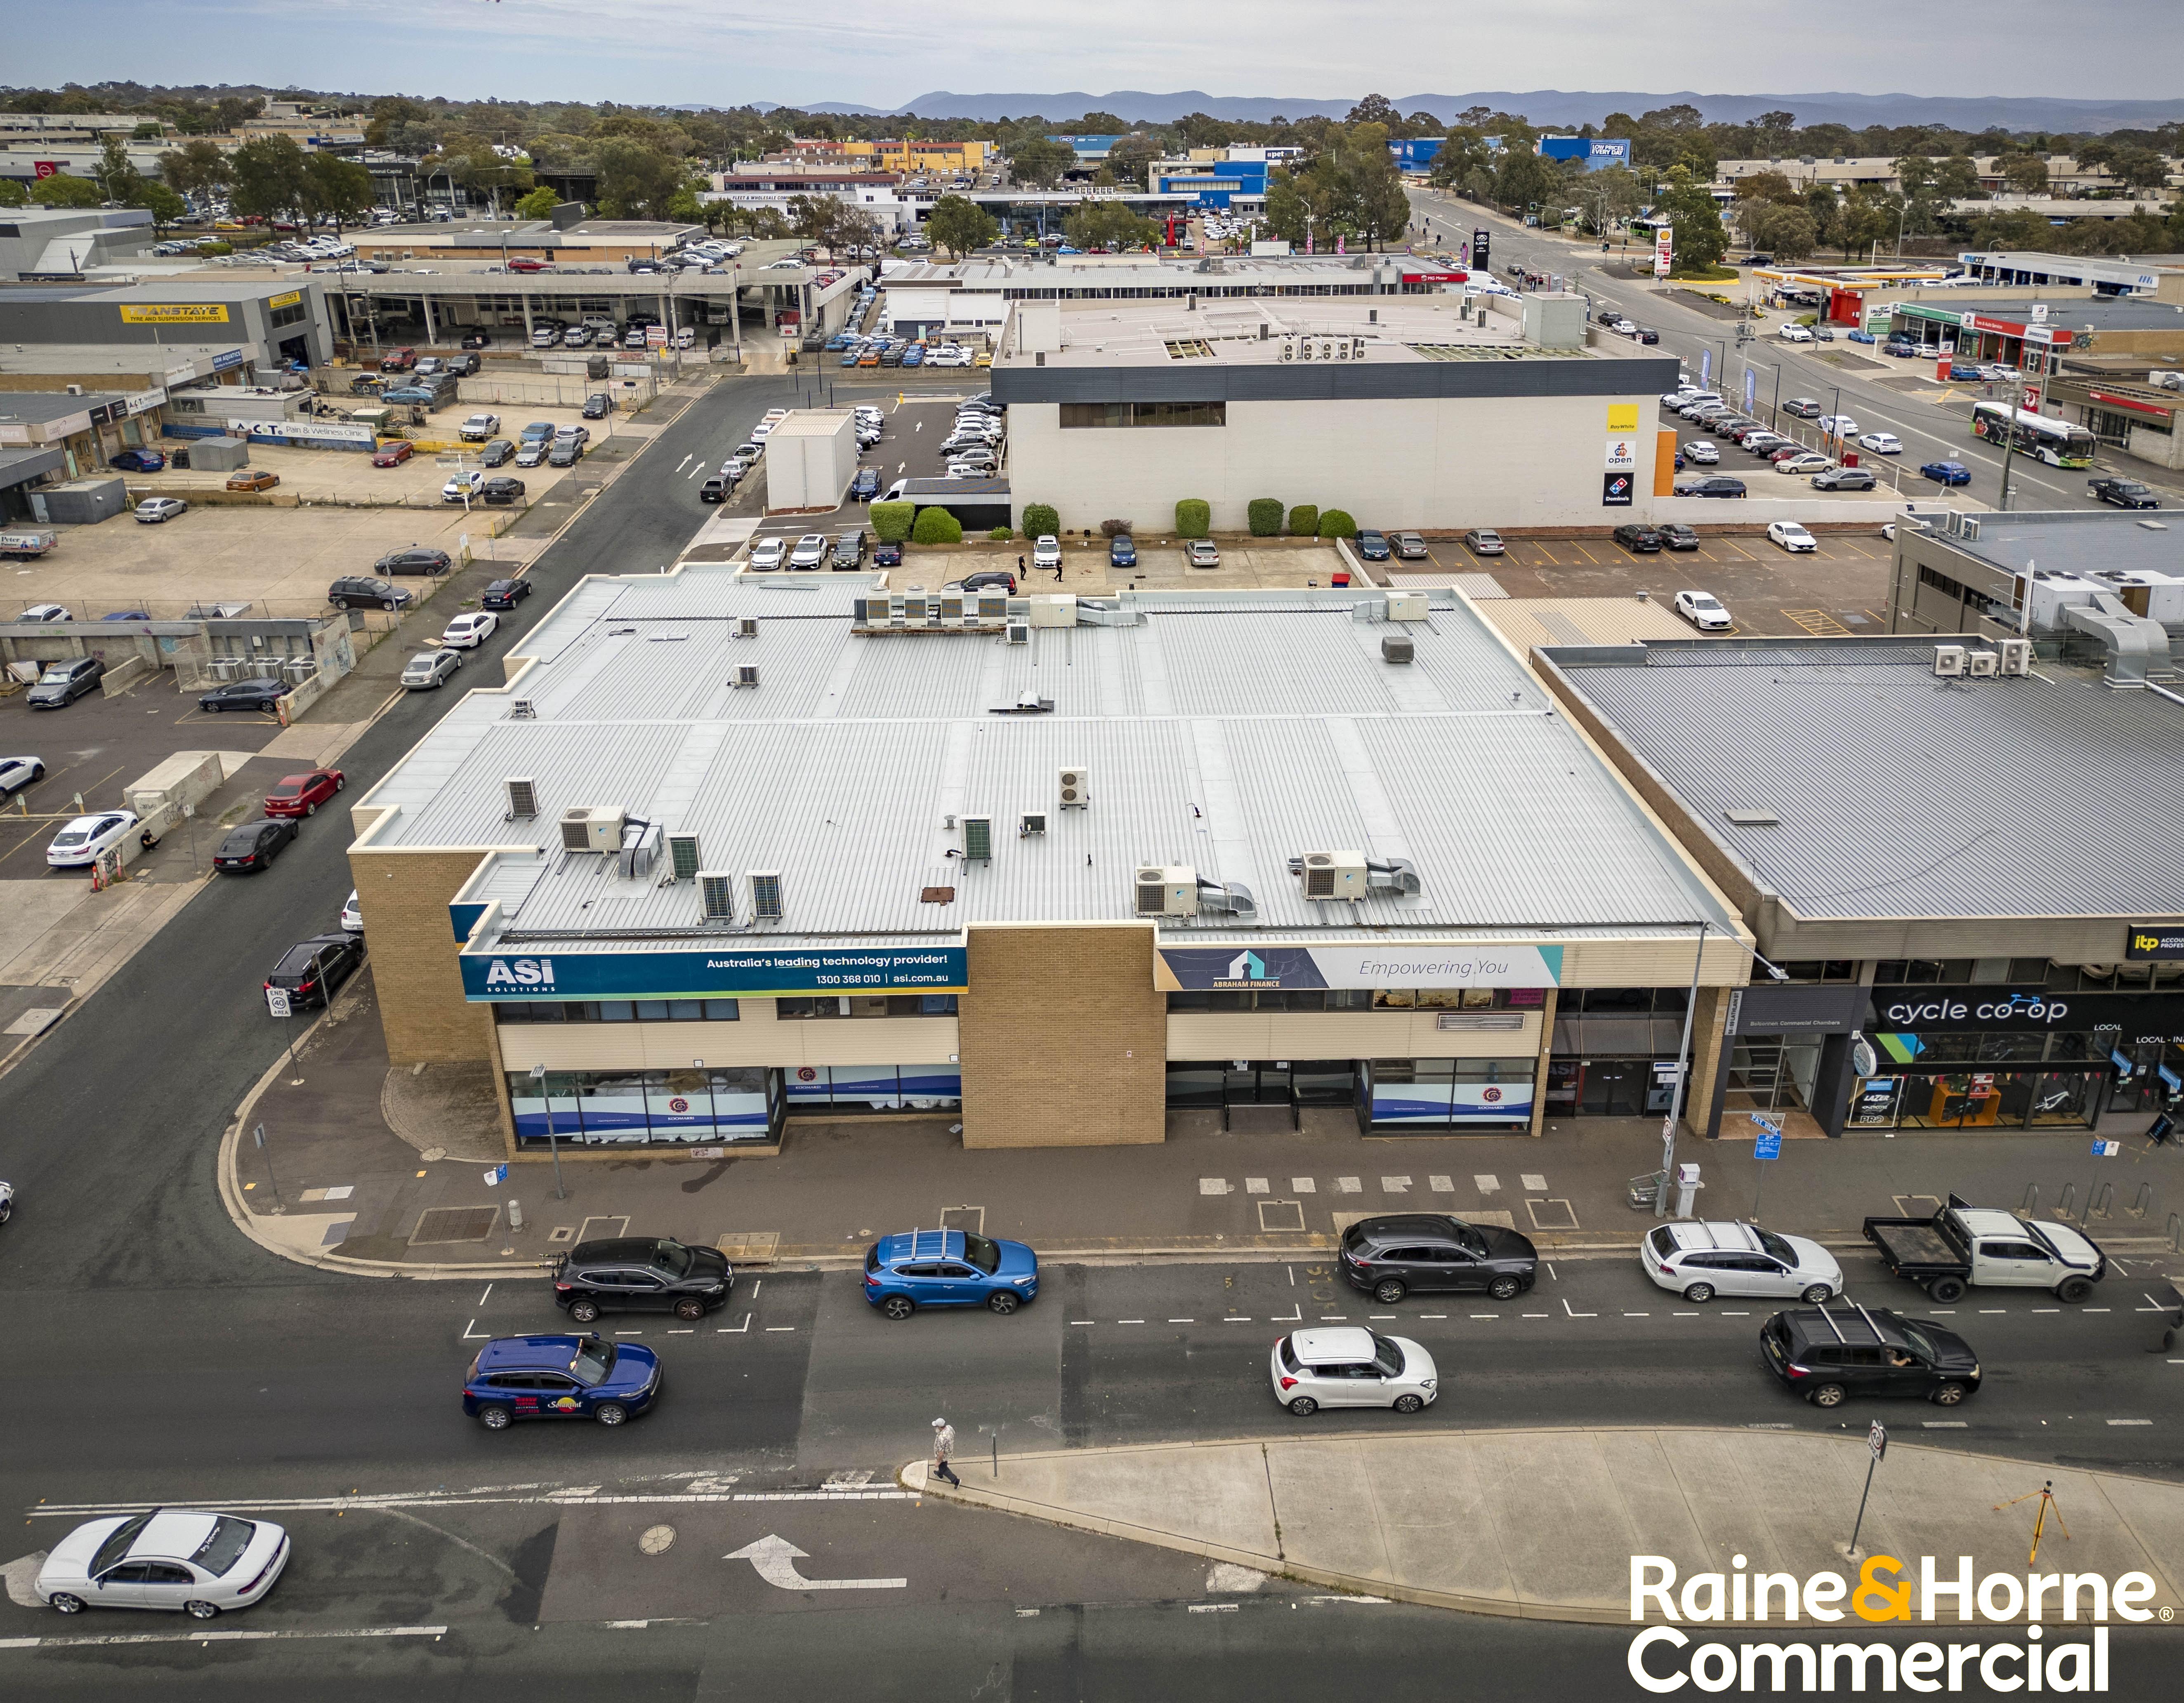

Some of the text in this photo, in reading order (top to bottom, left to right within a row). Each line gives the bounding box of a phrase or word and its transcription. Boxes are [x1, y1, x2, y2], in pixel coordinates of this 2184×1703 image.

[1964, 254, 1986, 264] mycar
[274, 292, 298, 303] TRANSTATE
[127, 307, 219, 316] TRANSTATE
[222, 351, 241, 361] AQUATICS
[310, 427, 343, 436] Wellness
[2135, 935, 2159, 952] itp
[707, 955, 948, 969] Australia's leading technology provider!
[1360, 960, 1508, 978] Empowering You
[486, 959, 554, 984] ASI
[816, 975, 840, 984] 1300
[842, 975, 861, 984] 368
[863, 974, 880, 983] 010
[893, 973, 948, 983] asi.com.au
[1888, 999, 2068, 1024] cycle co-op
[1752, 1114, 1781, 1136] PAY HERE
[1860, 1115, 1884, 1124] PRO
[1873, 1432, 1880, 1446] 40
[1868, 1442, 1878, 1458] AREA
